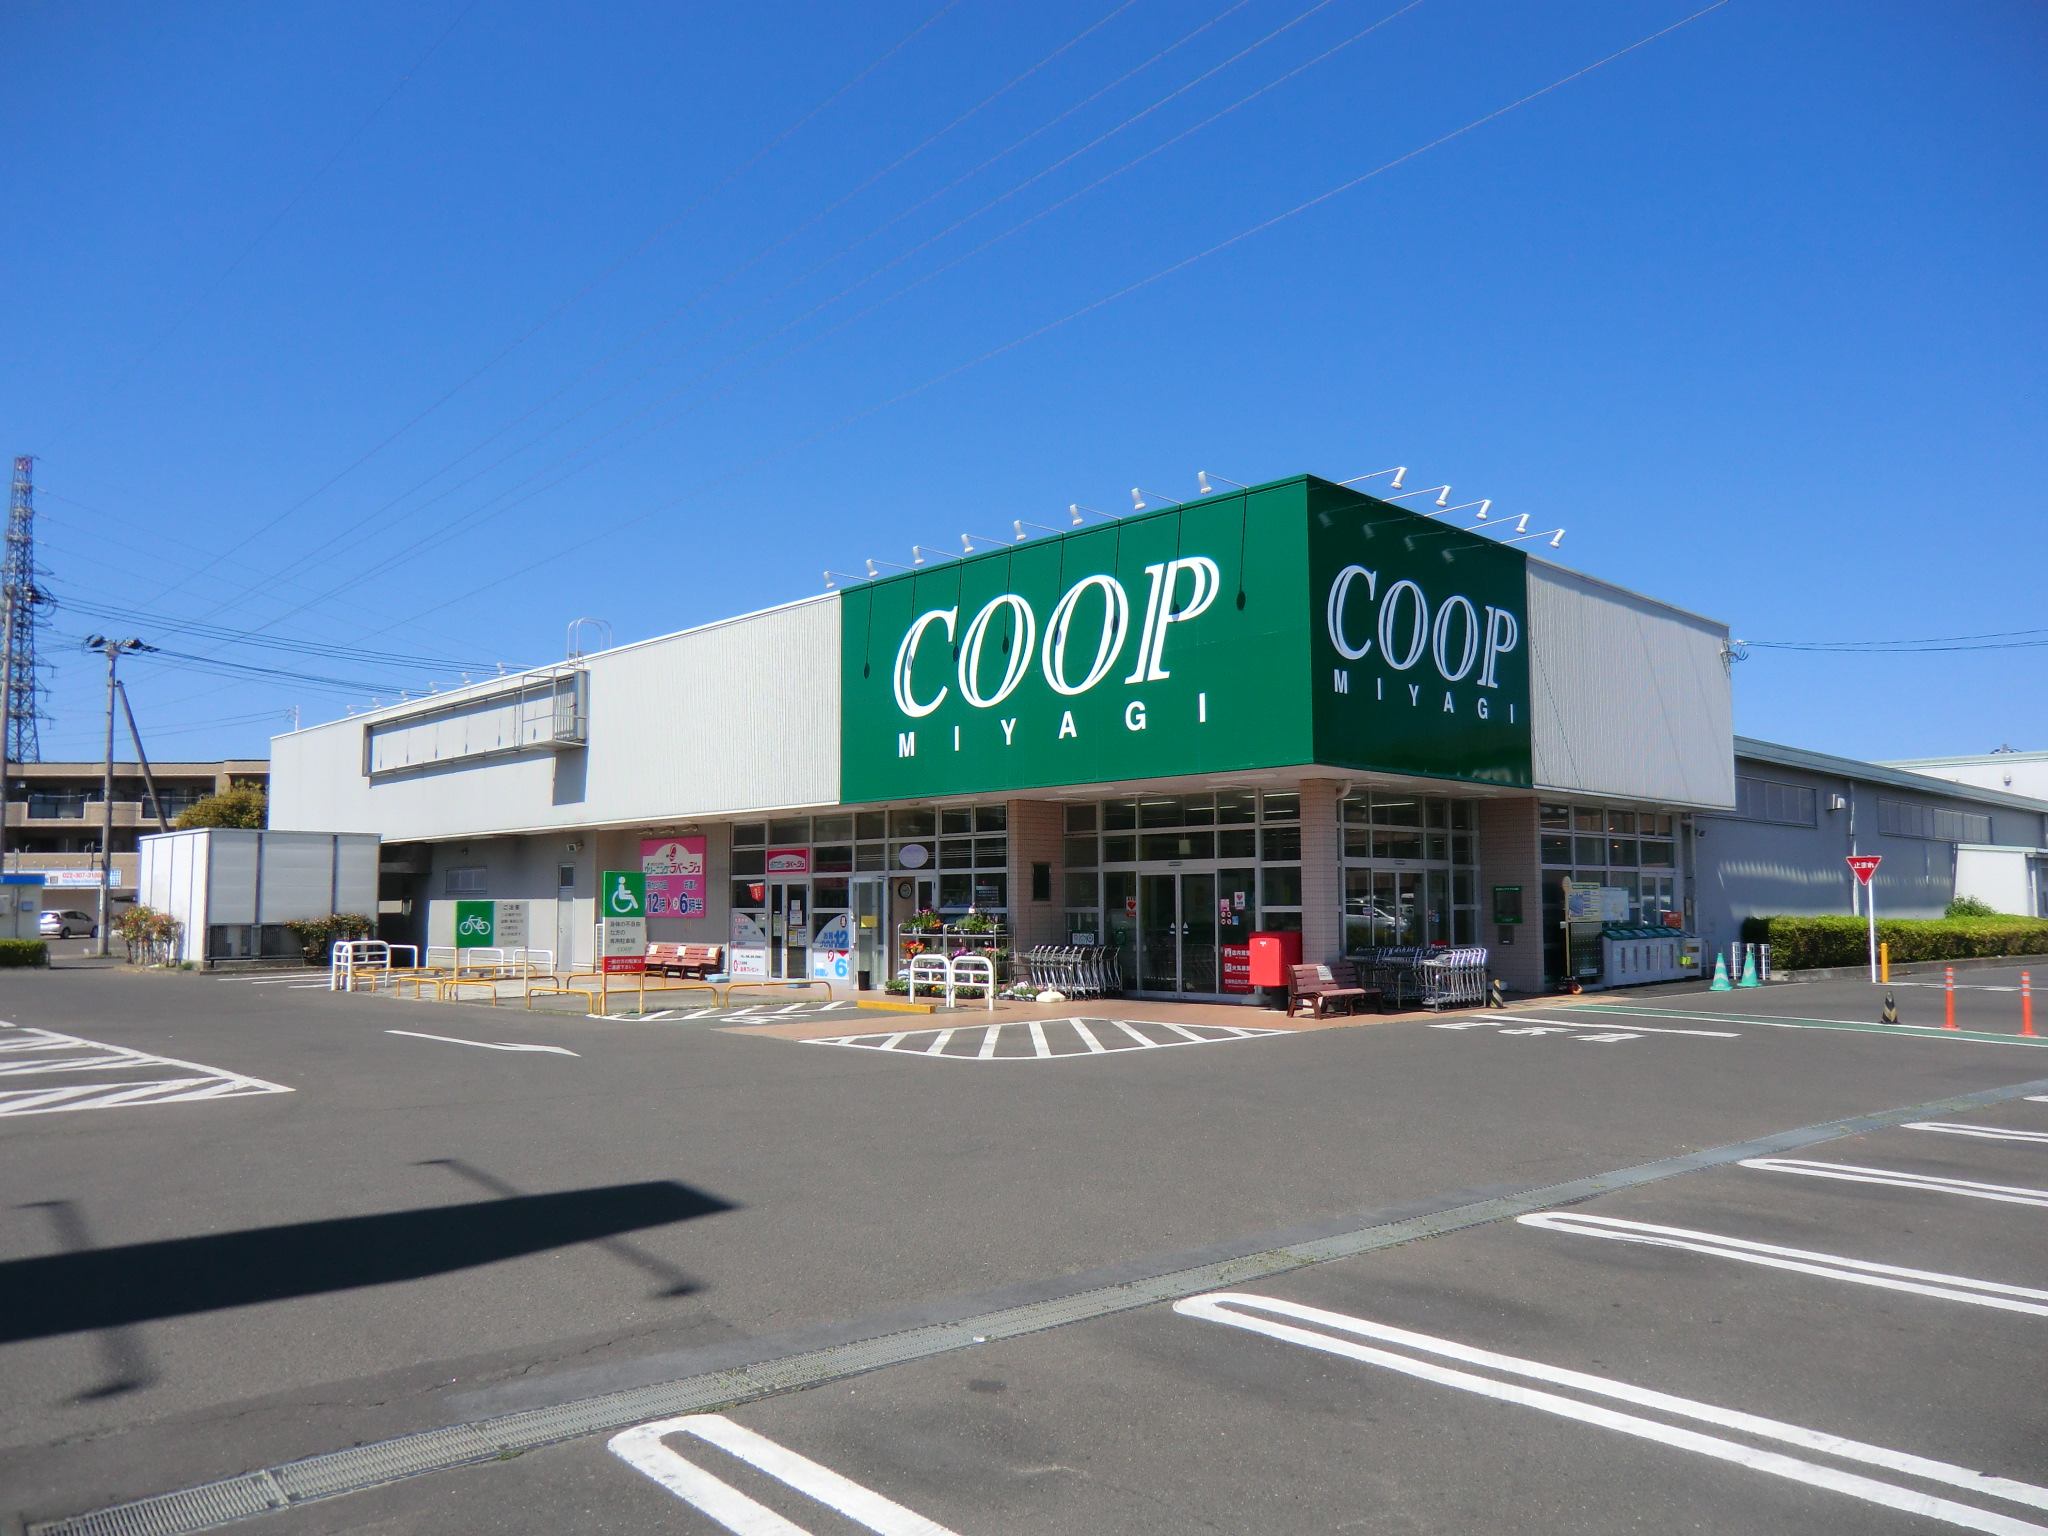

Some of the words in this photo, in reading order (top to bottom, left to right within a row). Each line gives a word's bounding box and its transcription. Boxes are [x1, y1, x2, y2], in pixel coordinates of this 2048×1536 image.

[893, 556, 1220, 718] COOP
[1327, 565, 1518, 689] COOP
[898, 692, 1206, 758] MIYAGI
[1333, 669, 1514, 724] MIYAGI
[1853, 861, 1875, 869] 止まれ
[835, 958, 848, 978] 6
